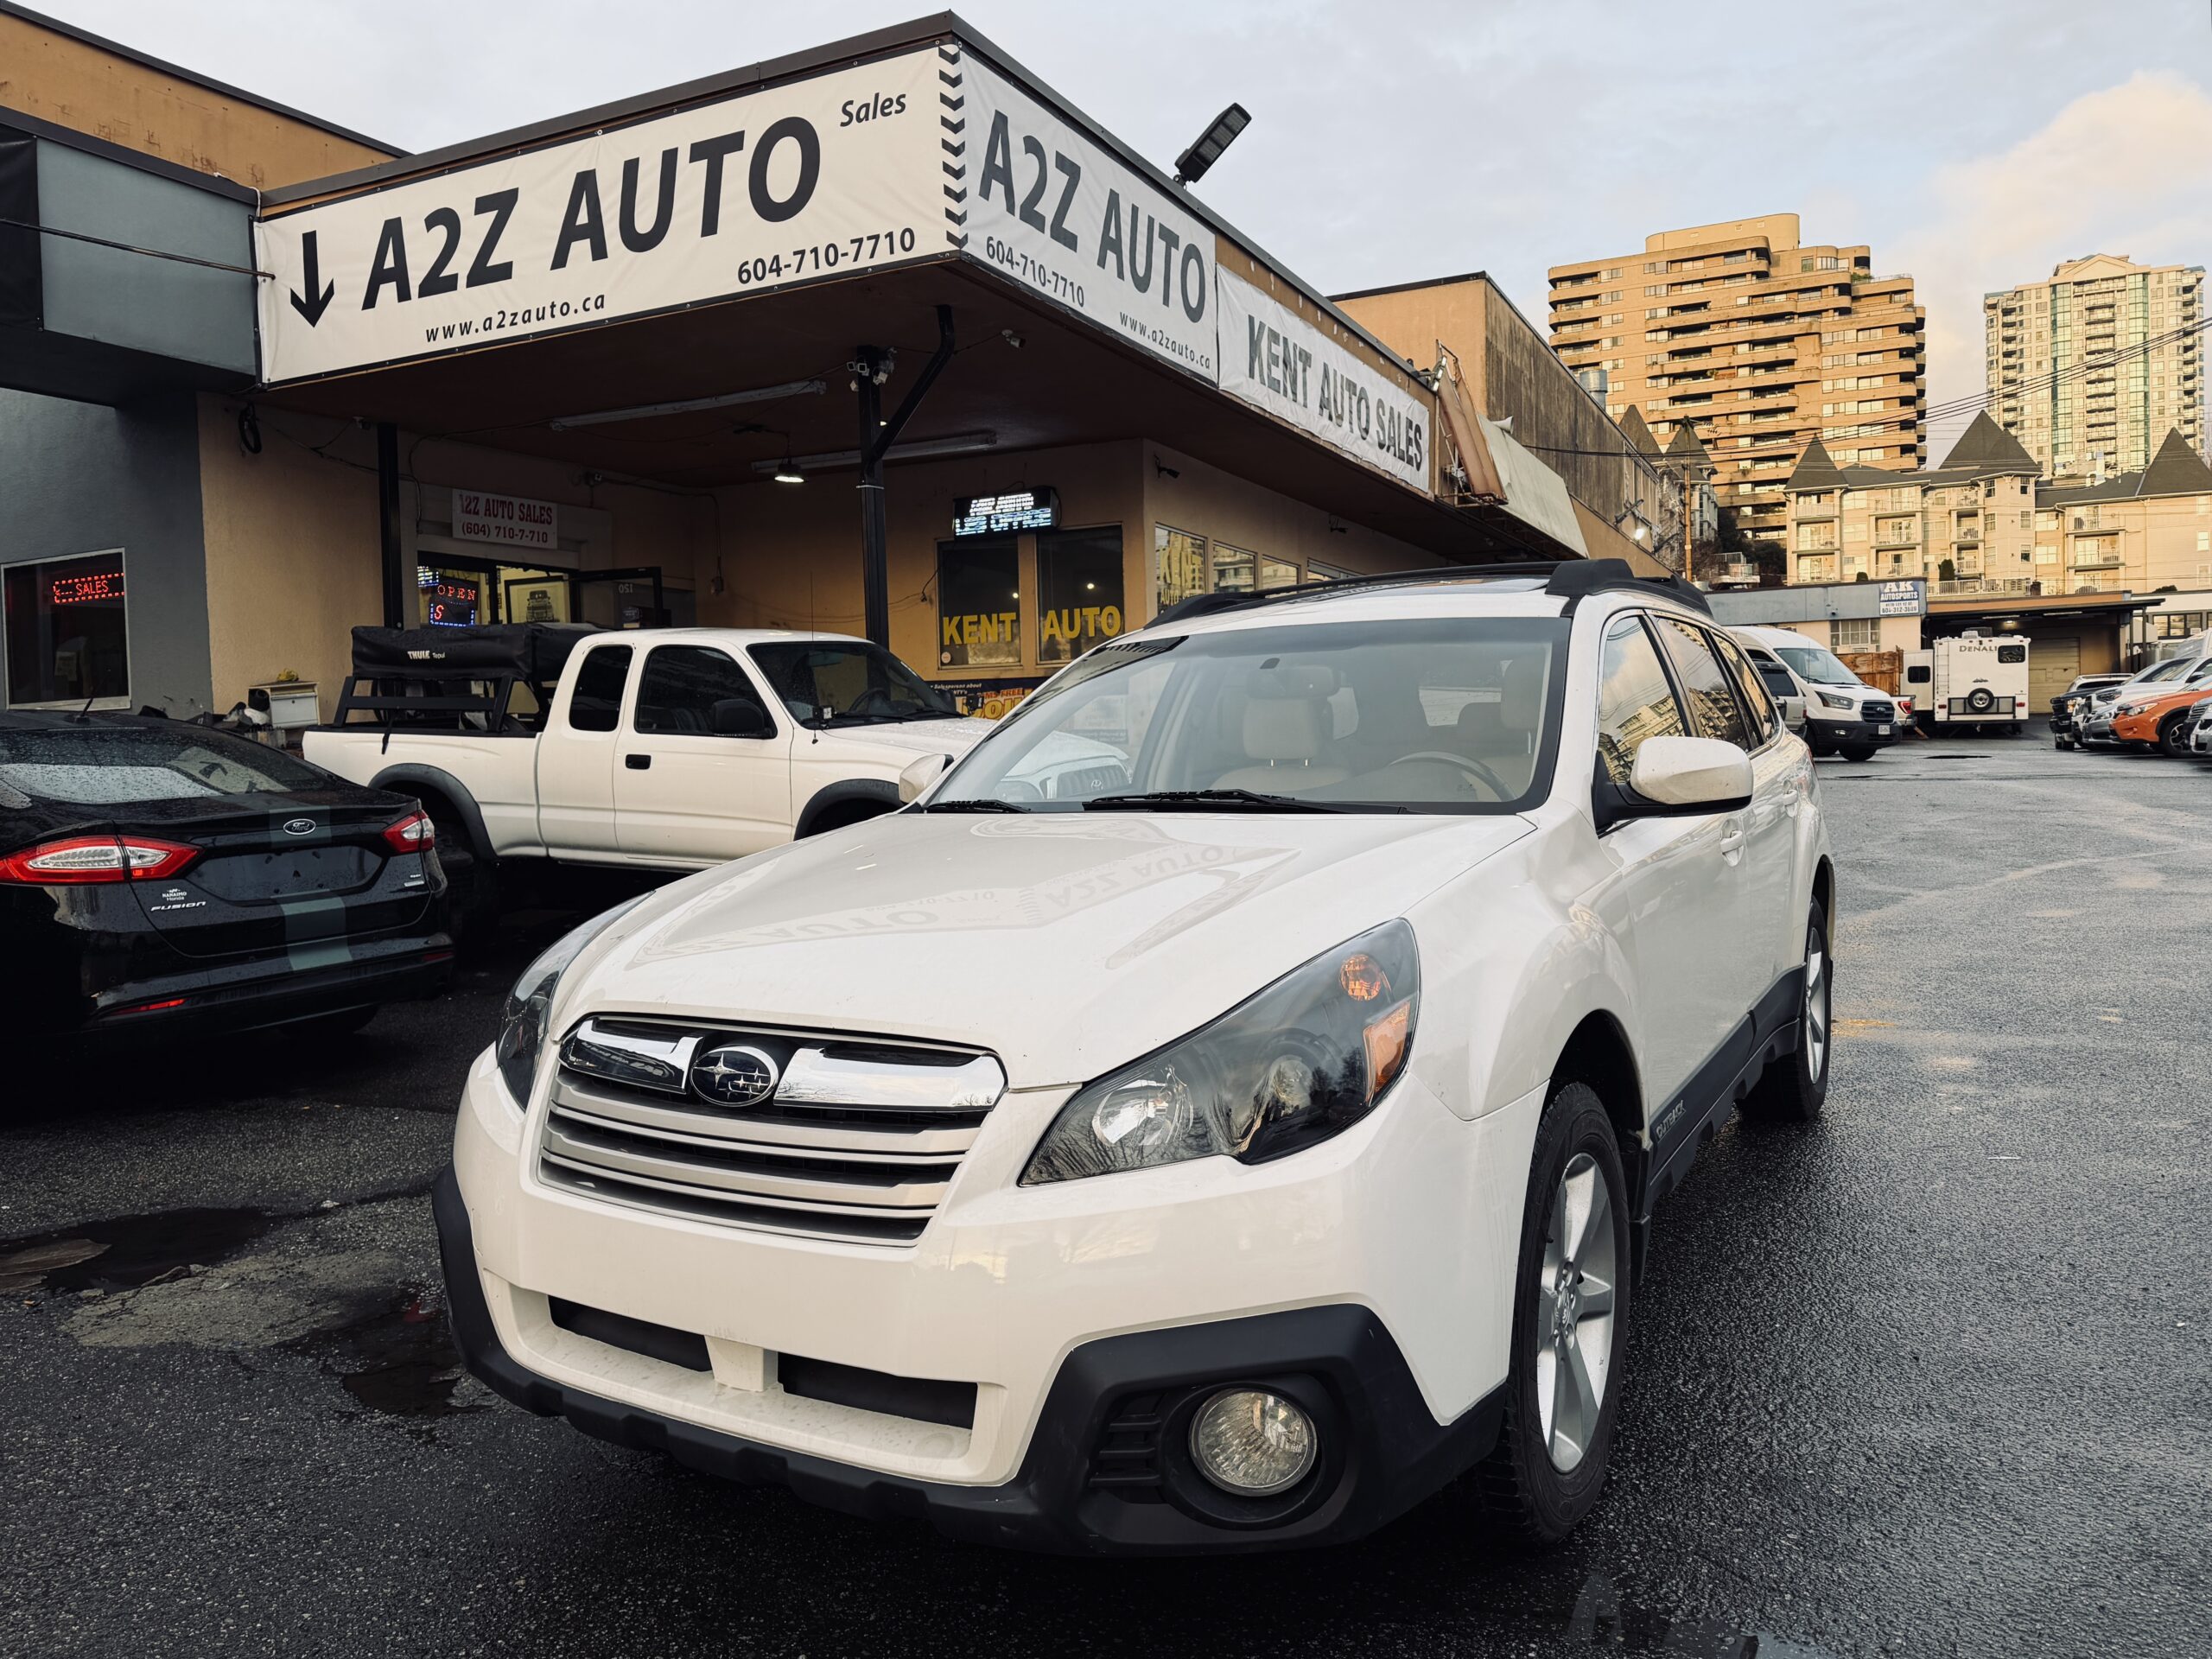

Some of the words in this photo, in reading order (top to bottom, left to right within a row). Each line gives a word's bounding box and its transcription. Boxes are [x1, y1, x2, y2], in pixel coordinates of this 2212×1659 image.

[361, 188, 518, 311] A2Z
[550, 117, 820, 271] AUTO
[840, 92, 906, 127] Sales
[978, 109, 1081, 252] A2Z
[1096, 188, 1205, 323] AUTO
[738, 227, 915, 284] 604-710-7710
[986, 236, 1084, 308] 604-710-7710
[426, 294, 605, 343] www.a2zauto.ca
[1120, 312, 1210, 369] www.a2zauto.ca
[1248, 315, 1312, 408] KENT
[1319, 362, 1370, 441] AUTO
[1376, 398, 1422, 472] SALES
[484, 498, 514, 520] AUTO
[518, 503, 553, 525] SALES
[461, 521, 491, 538] (604)
[495, 526, 548, 543] 710-7-710
[76, 581, 109, 595] SALES
[437, 585, 476, 601] OPEN
[1880, 592, 1918, 601] AUTOSPORTS
[1884, 581, 1914, 593] AK
[943, 613, 1016, 645] KENT
[1043, 606, 1121, 642] AUTO
[407, 651, 430, 659] THULE
[150, 901, 207, 912] FUSION
